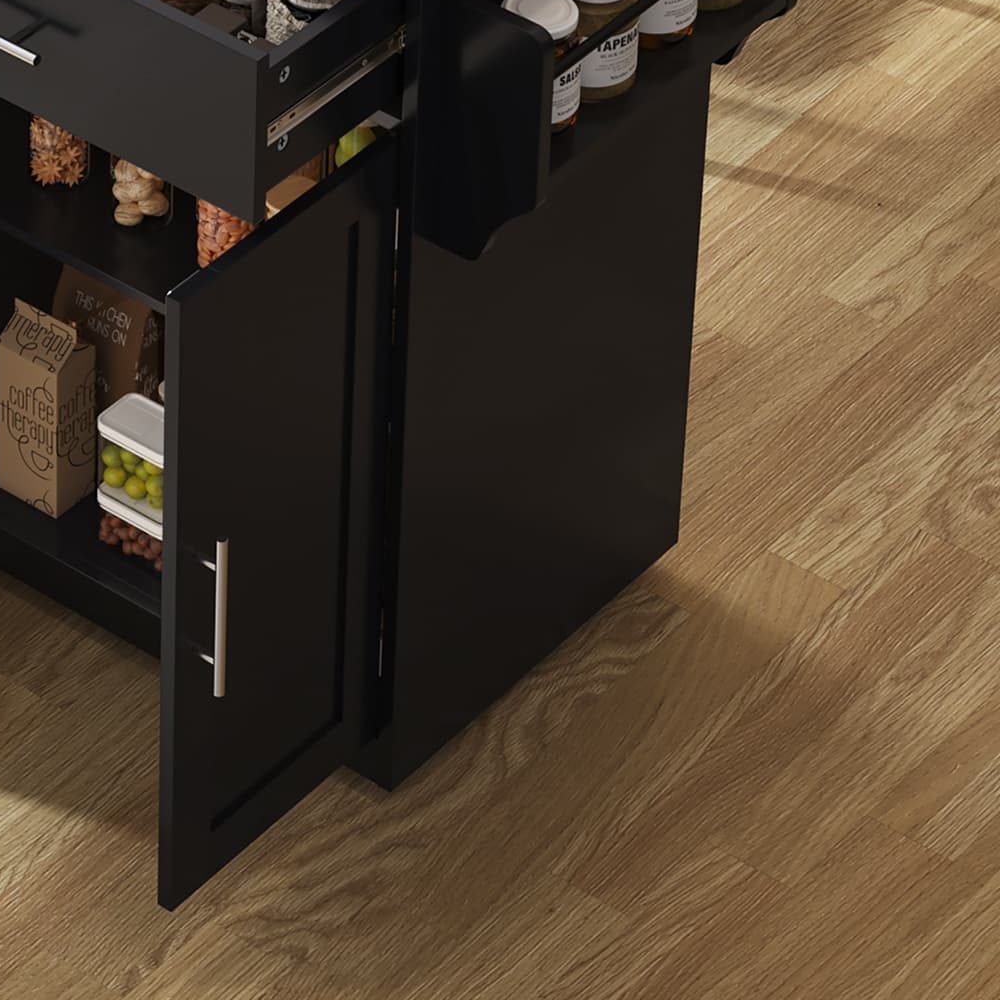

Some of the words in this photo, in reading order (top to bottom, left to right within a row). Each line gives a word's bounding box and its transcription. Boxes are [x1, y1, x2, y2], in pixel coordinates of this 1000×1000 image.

[559, 64, 582, 86] SALS
[111, 329, 127, 347] ON
[8, 378, 54, 425] coffee
